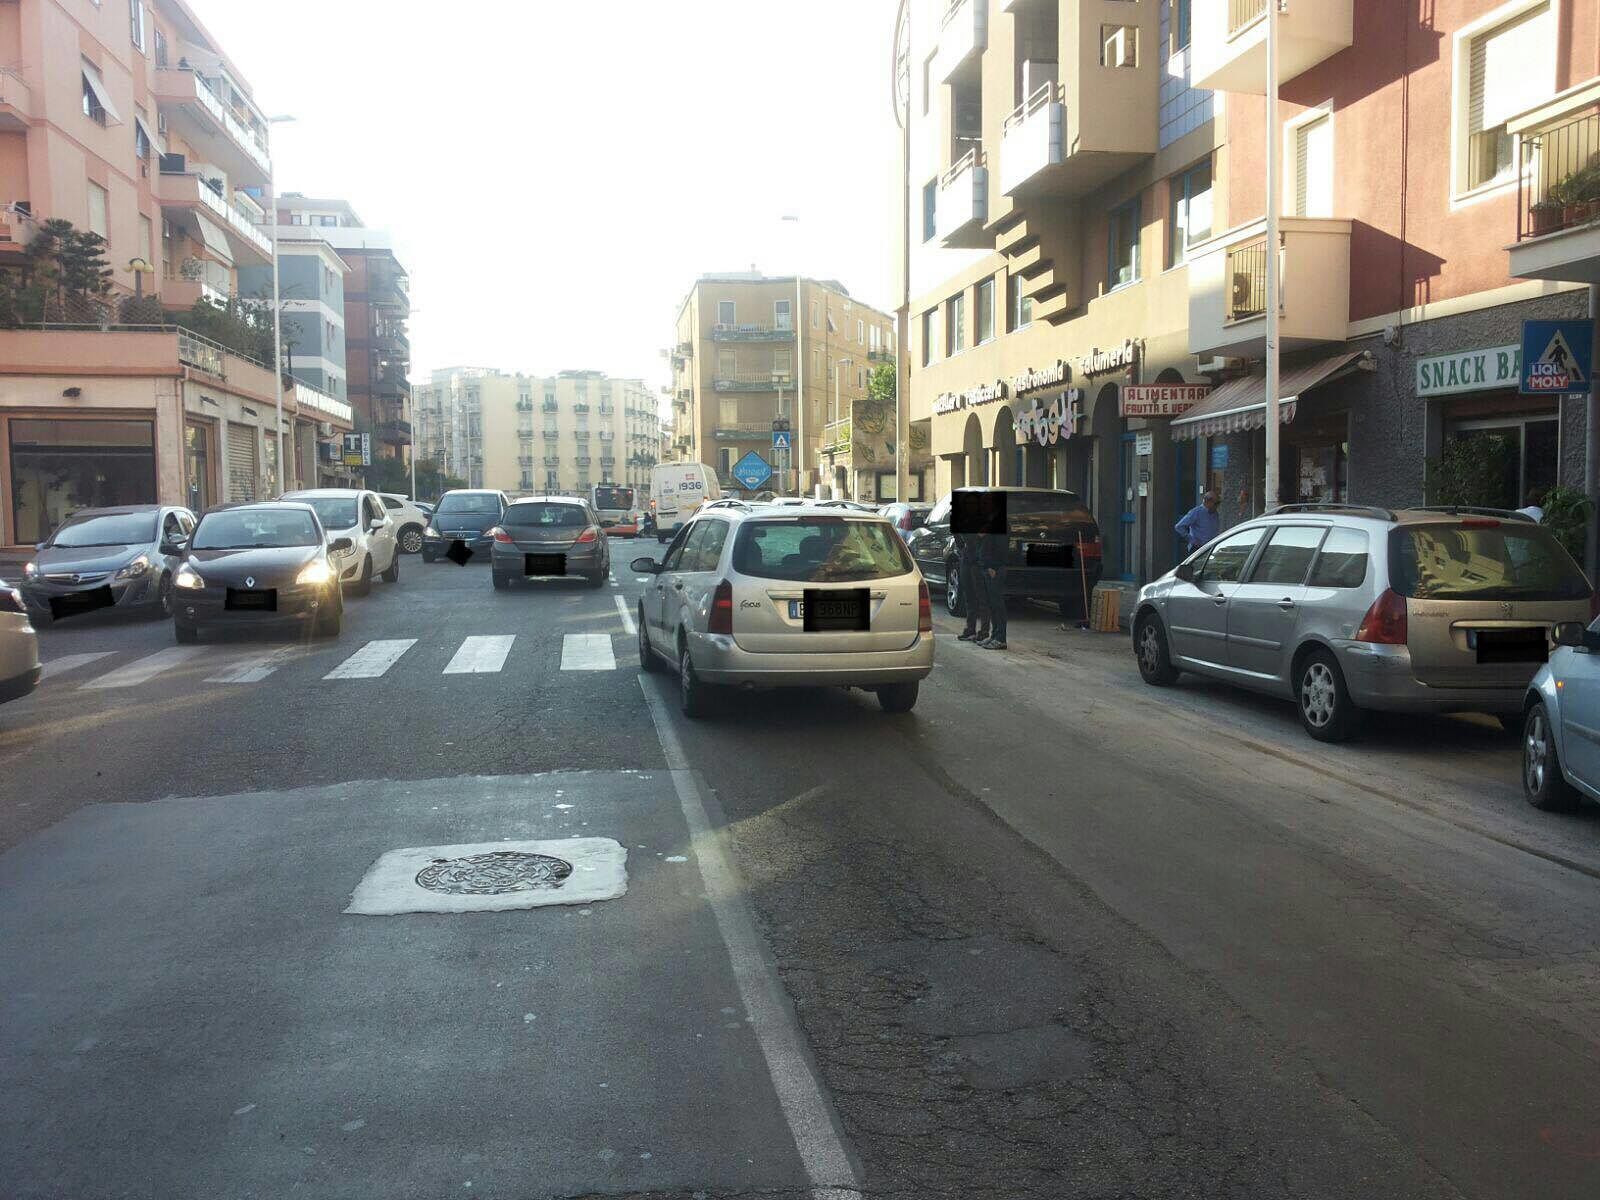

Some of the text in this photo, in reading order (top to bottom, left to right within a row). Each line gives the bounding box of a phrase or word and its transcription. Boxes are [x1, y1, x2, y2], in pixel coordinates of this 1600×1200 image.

[1421, 350, 1521, 389] SNACK BA
[1531, 376, 1567, 388] MOLY
[1125, 403, 1160, 413] FRUTTA
[1162, 403, 1168, 413] E
